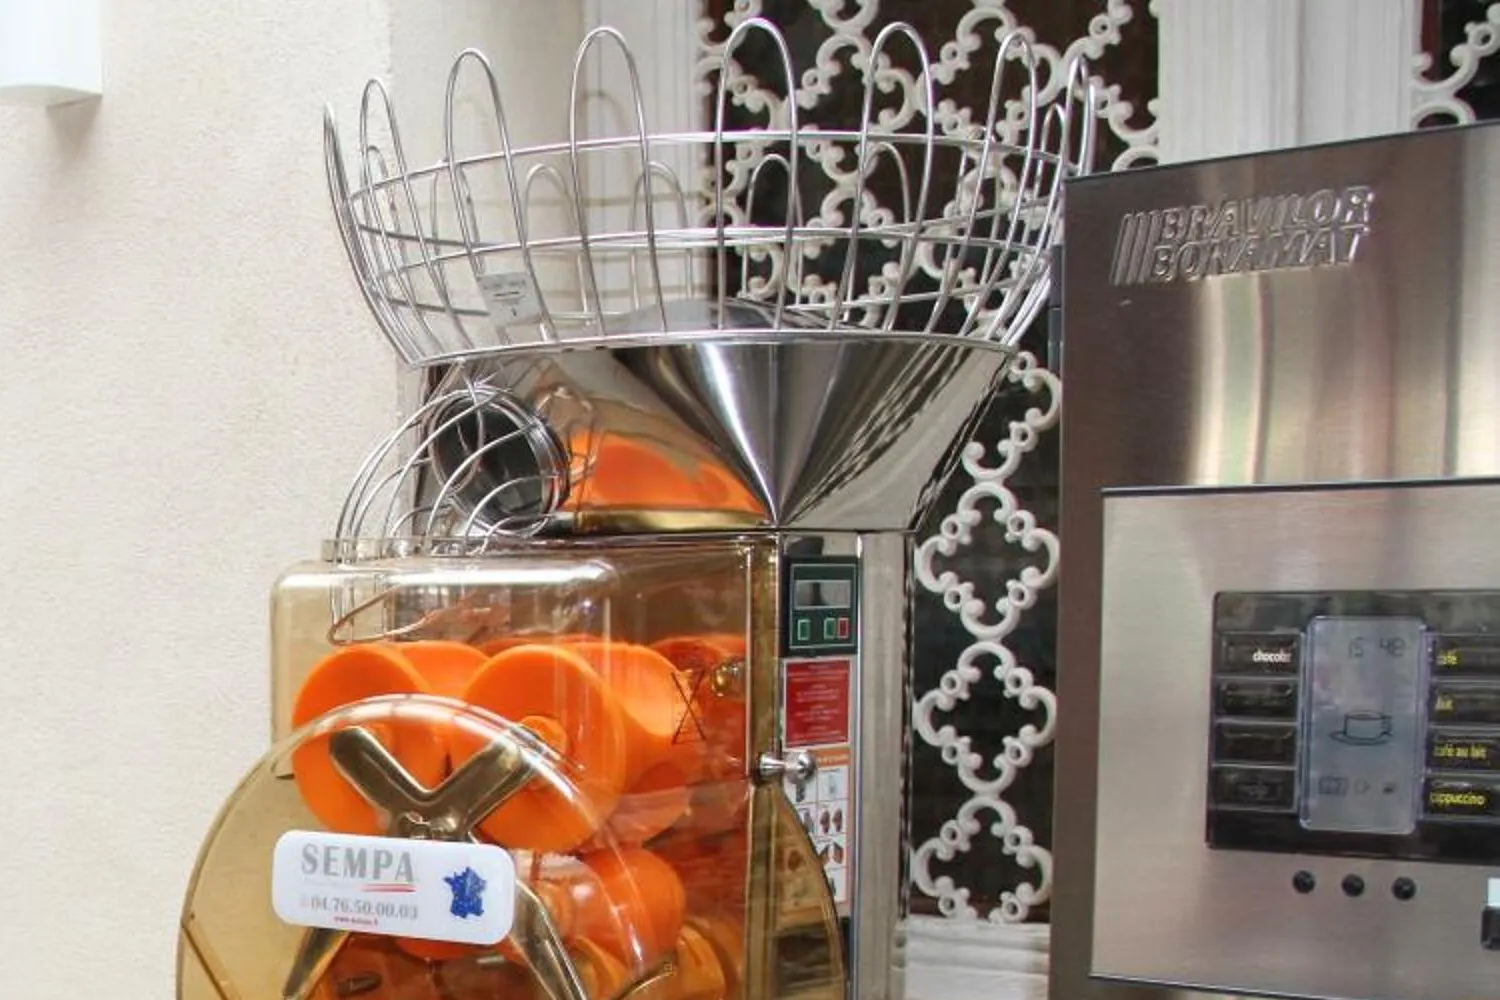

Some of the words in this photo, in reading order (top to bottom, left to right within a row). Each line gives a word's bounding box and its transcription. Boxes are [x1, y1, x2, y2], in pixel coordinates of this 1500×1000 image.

[1159, 186, 1375, 242] BRAVILOR
[1152, 223, 1371, 281] BONAMAT
[301, 842, 414, 882] SEMPA
